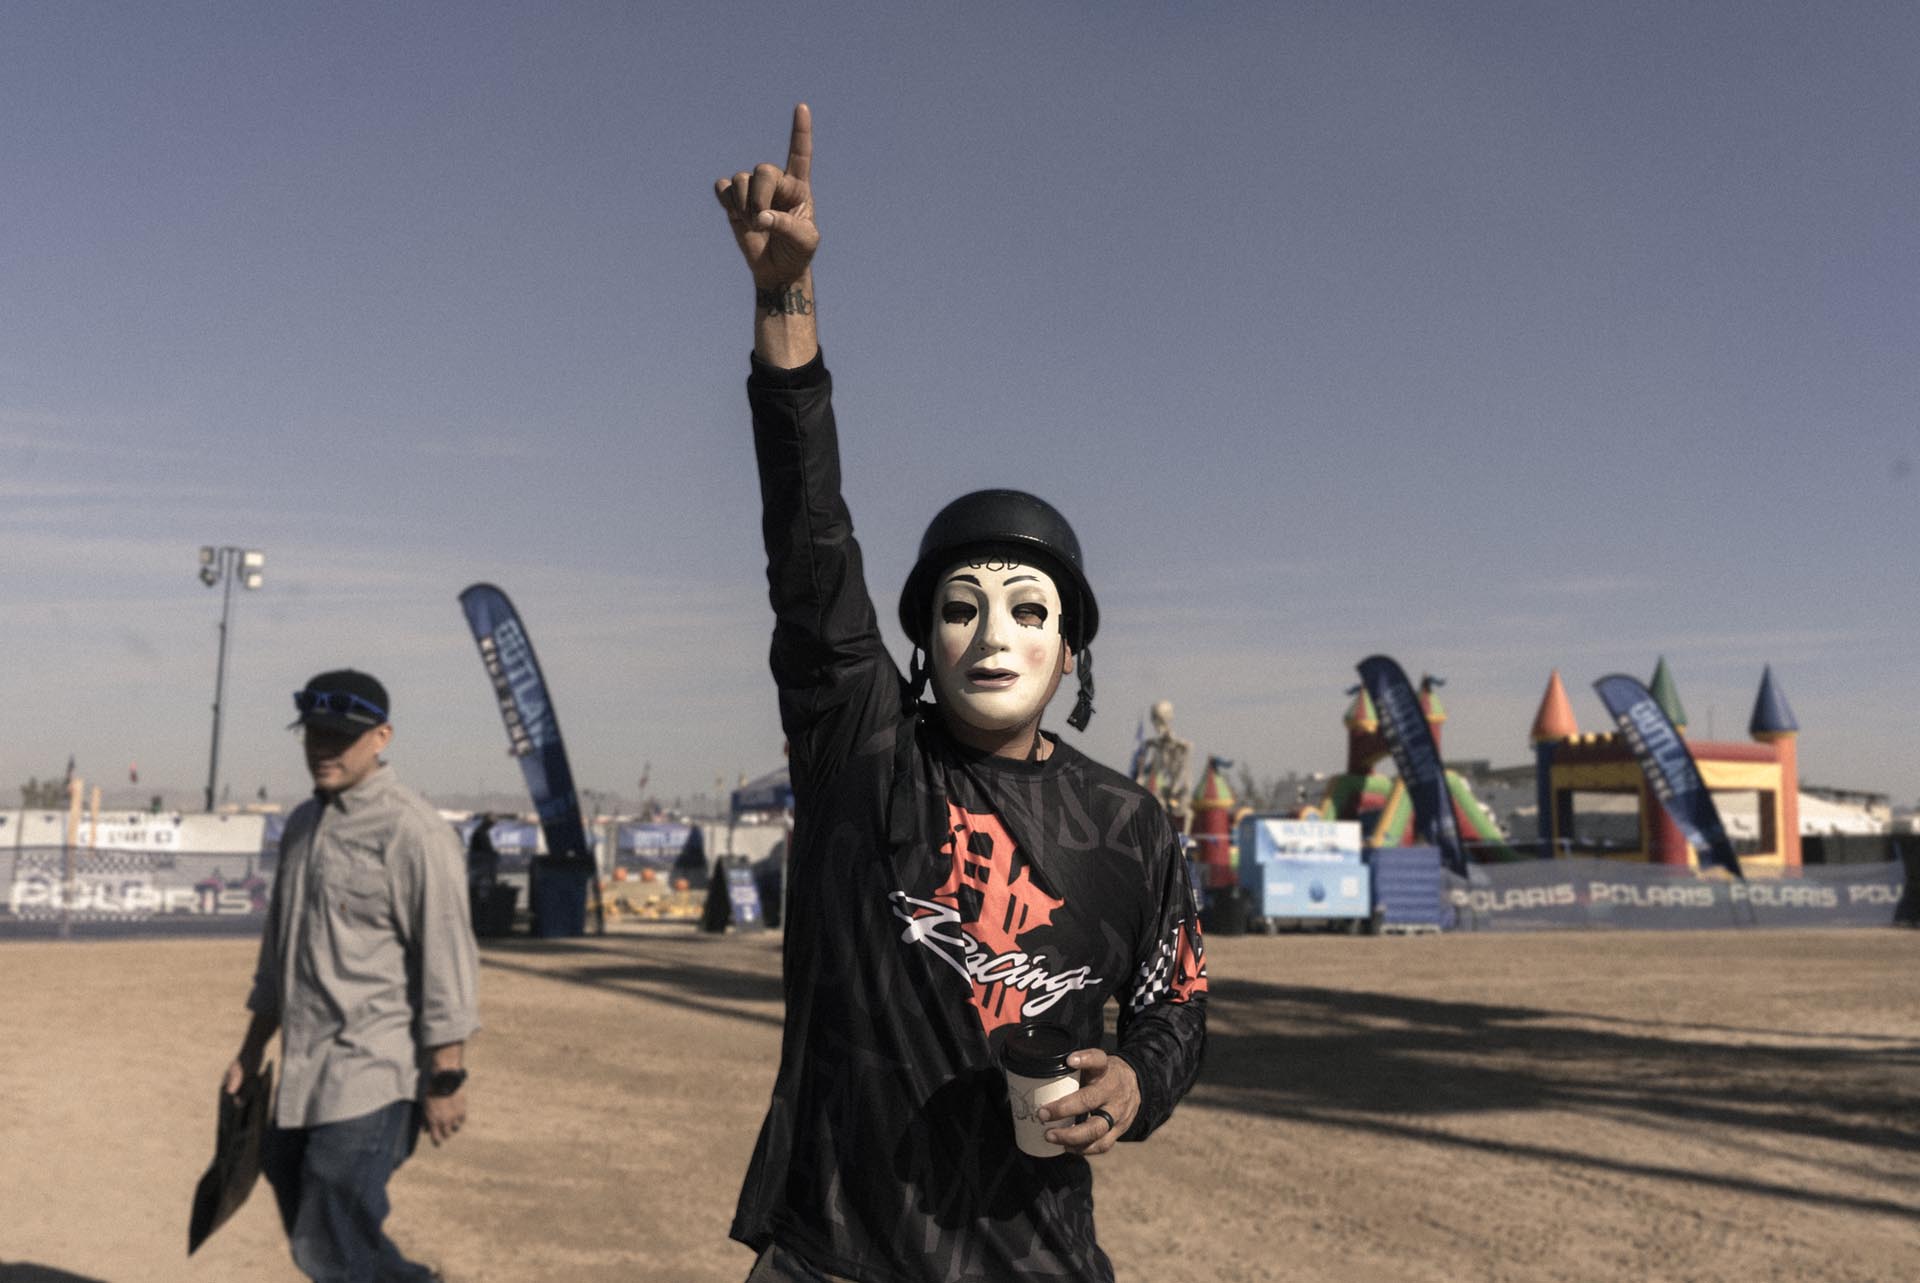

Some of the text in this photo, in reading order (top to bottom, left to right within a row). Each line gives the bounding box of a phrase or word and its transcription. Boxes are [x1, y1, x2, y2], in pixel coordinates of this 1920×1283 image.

[1450, 883, 1576, 911] POLARIS
[1589, 881, 1714, 907] POLARIS
[1729, 884, 1838, 908] POLARIS
[888, 890, 1103, 1017] Racing
